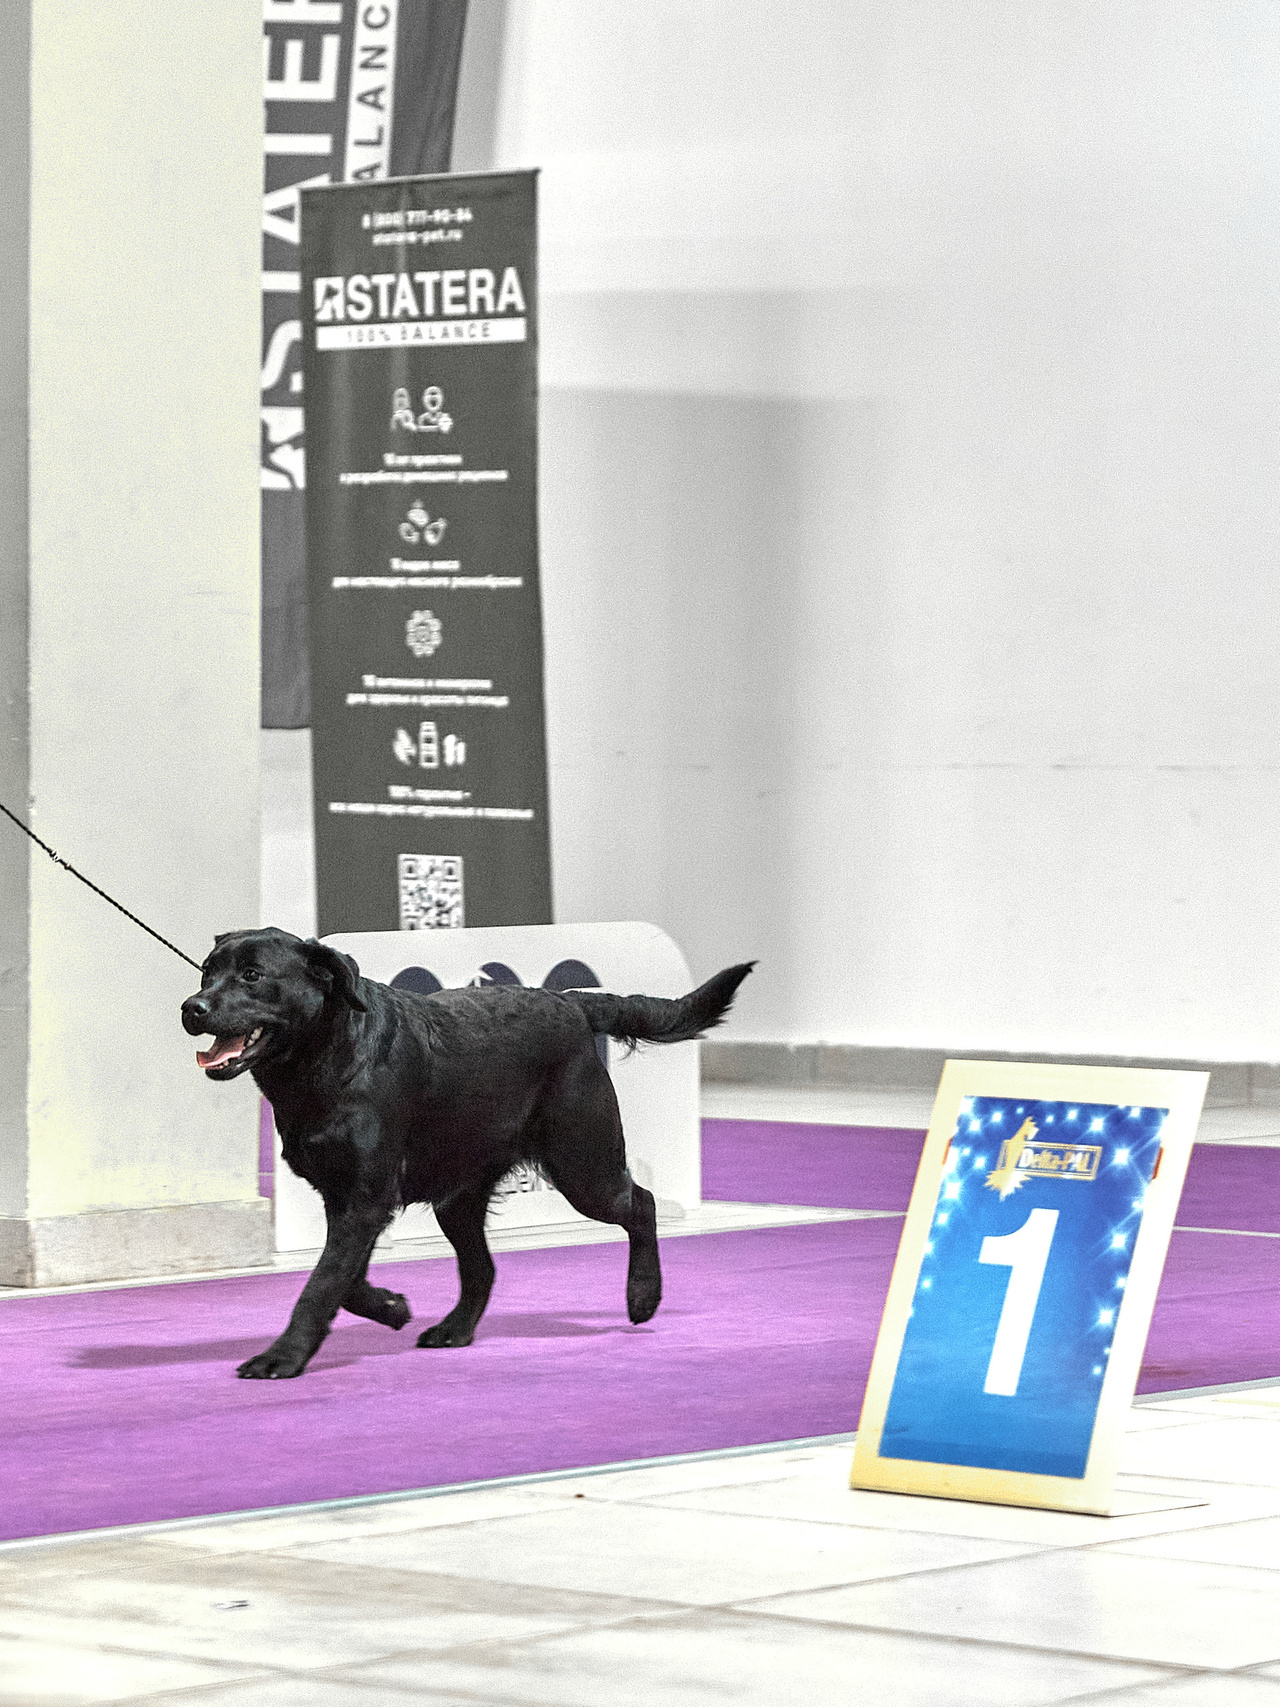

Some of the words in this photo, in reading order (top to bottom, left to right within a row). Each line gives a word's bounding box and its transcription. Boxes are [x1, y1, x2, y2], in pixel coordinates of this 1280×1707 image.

[346, 266, 526, 321] STATERA
[347, 328, 391, 343] 100%
[400, 321, 491, 341] BALANCE
[977, 1207, 1061, 1397] 1
